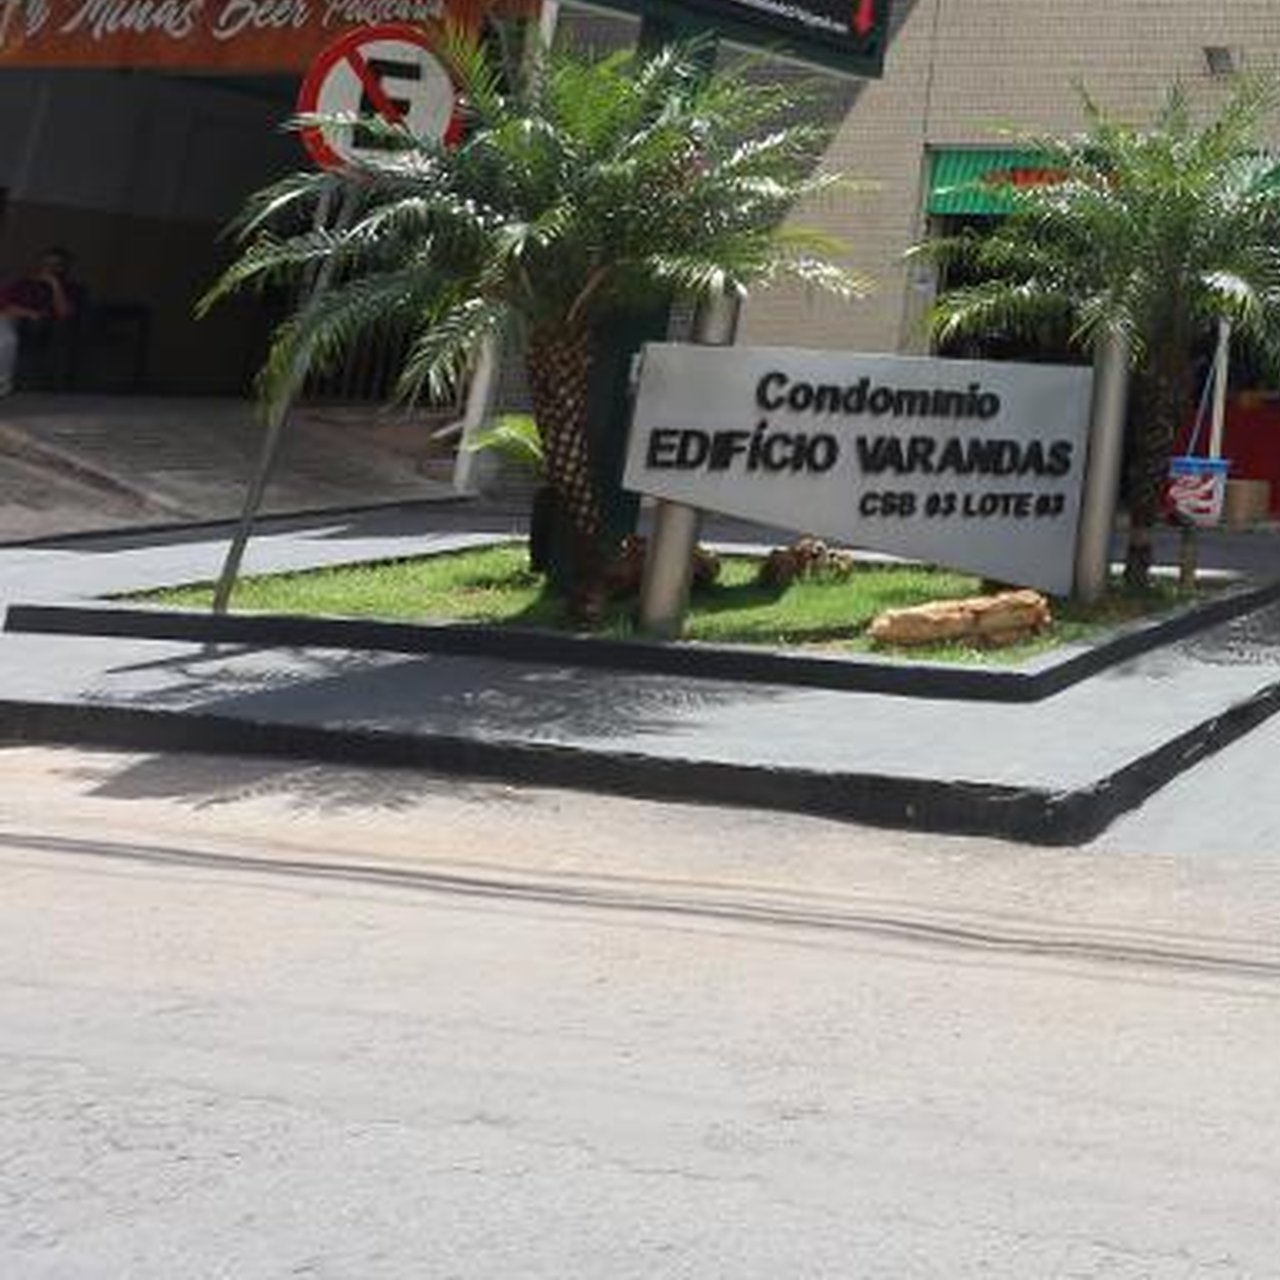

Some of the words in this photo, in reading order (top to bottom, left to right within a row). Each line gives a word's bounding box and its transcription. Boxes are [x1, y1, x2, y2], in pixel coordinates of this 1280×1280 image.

[646, 421, 839, 474] EDIFÍCIO
[857, 434, 1073, 477] VARANDAS
[858, 491, 917, 518] CSB
[963, 492, 1034, 519] LOTE
